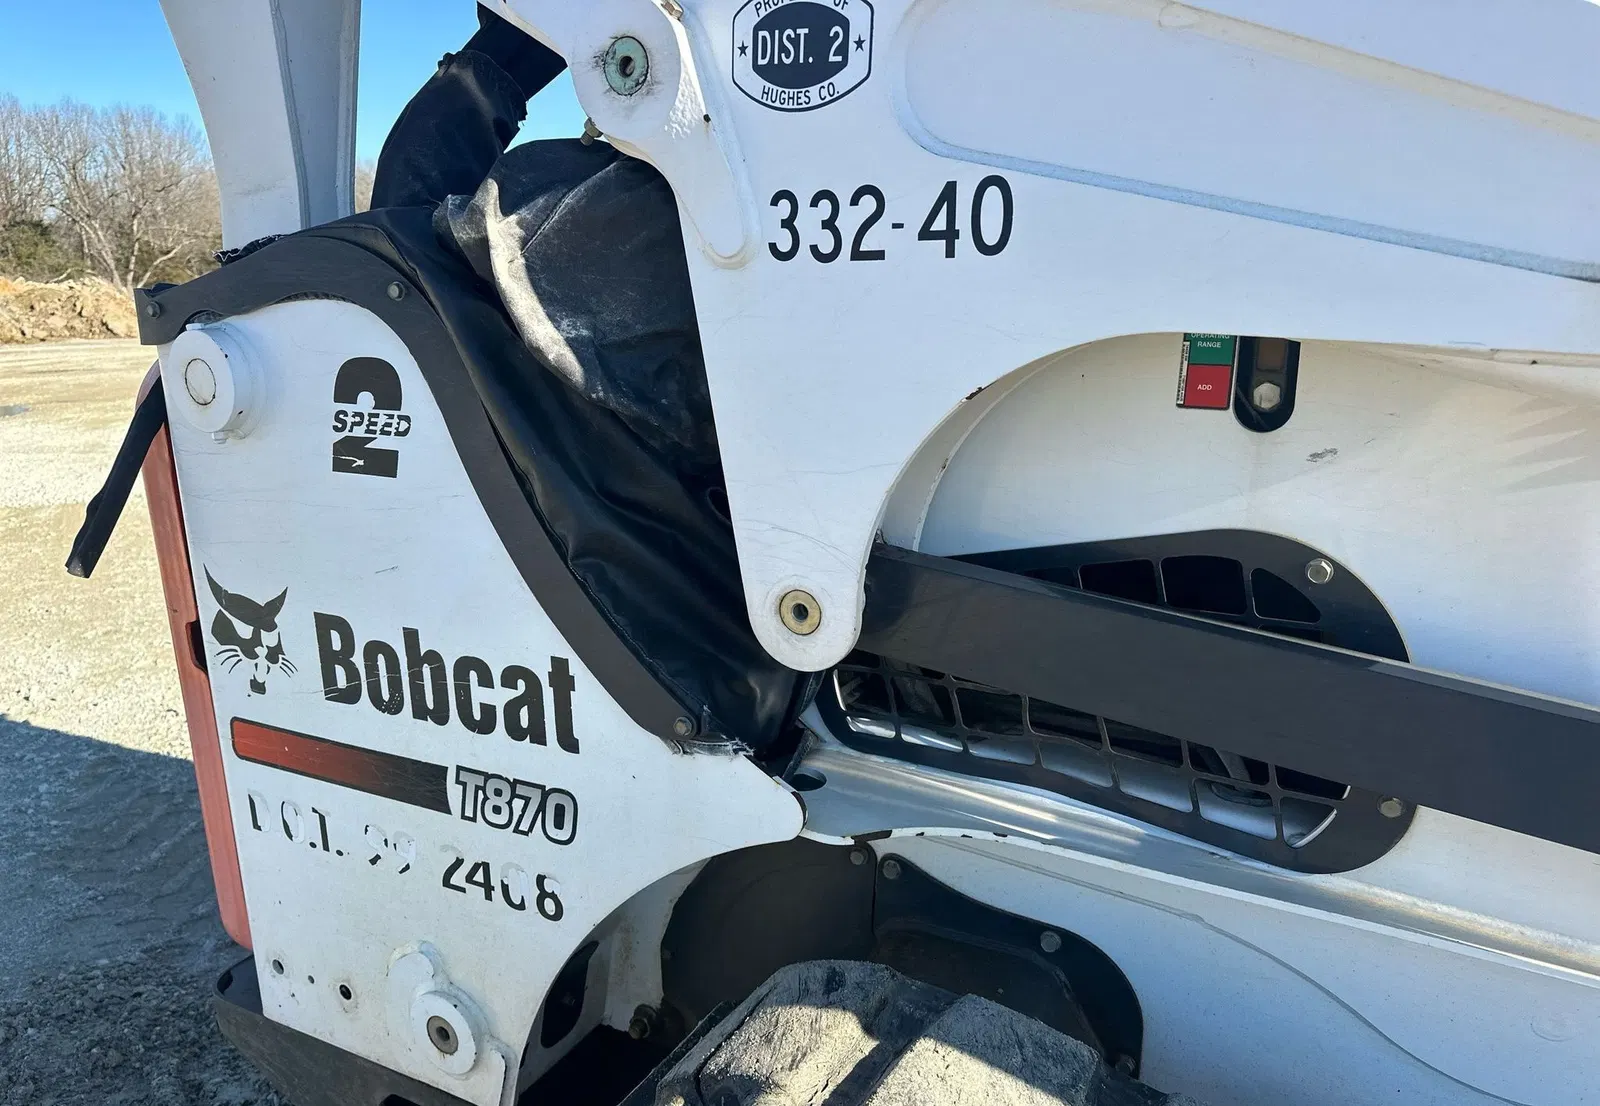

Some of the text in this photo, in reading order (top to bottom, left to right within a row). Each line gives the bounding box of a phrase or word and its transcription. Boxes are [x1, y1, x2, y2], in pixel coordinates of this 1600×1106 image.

[757, 25, 844, 65] DIST. 2
[761, 82, 840, 106] HUGHES CO.
[768, 174, 1014, 264] 332-40
[1197, 382, 1212, 390] ADD
[332, 409, 412, 437] SPEED
[313, 611, 580, 754] Bobcat
[455, 764, 578, 845] T870
